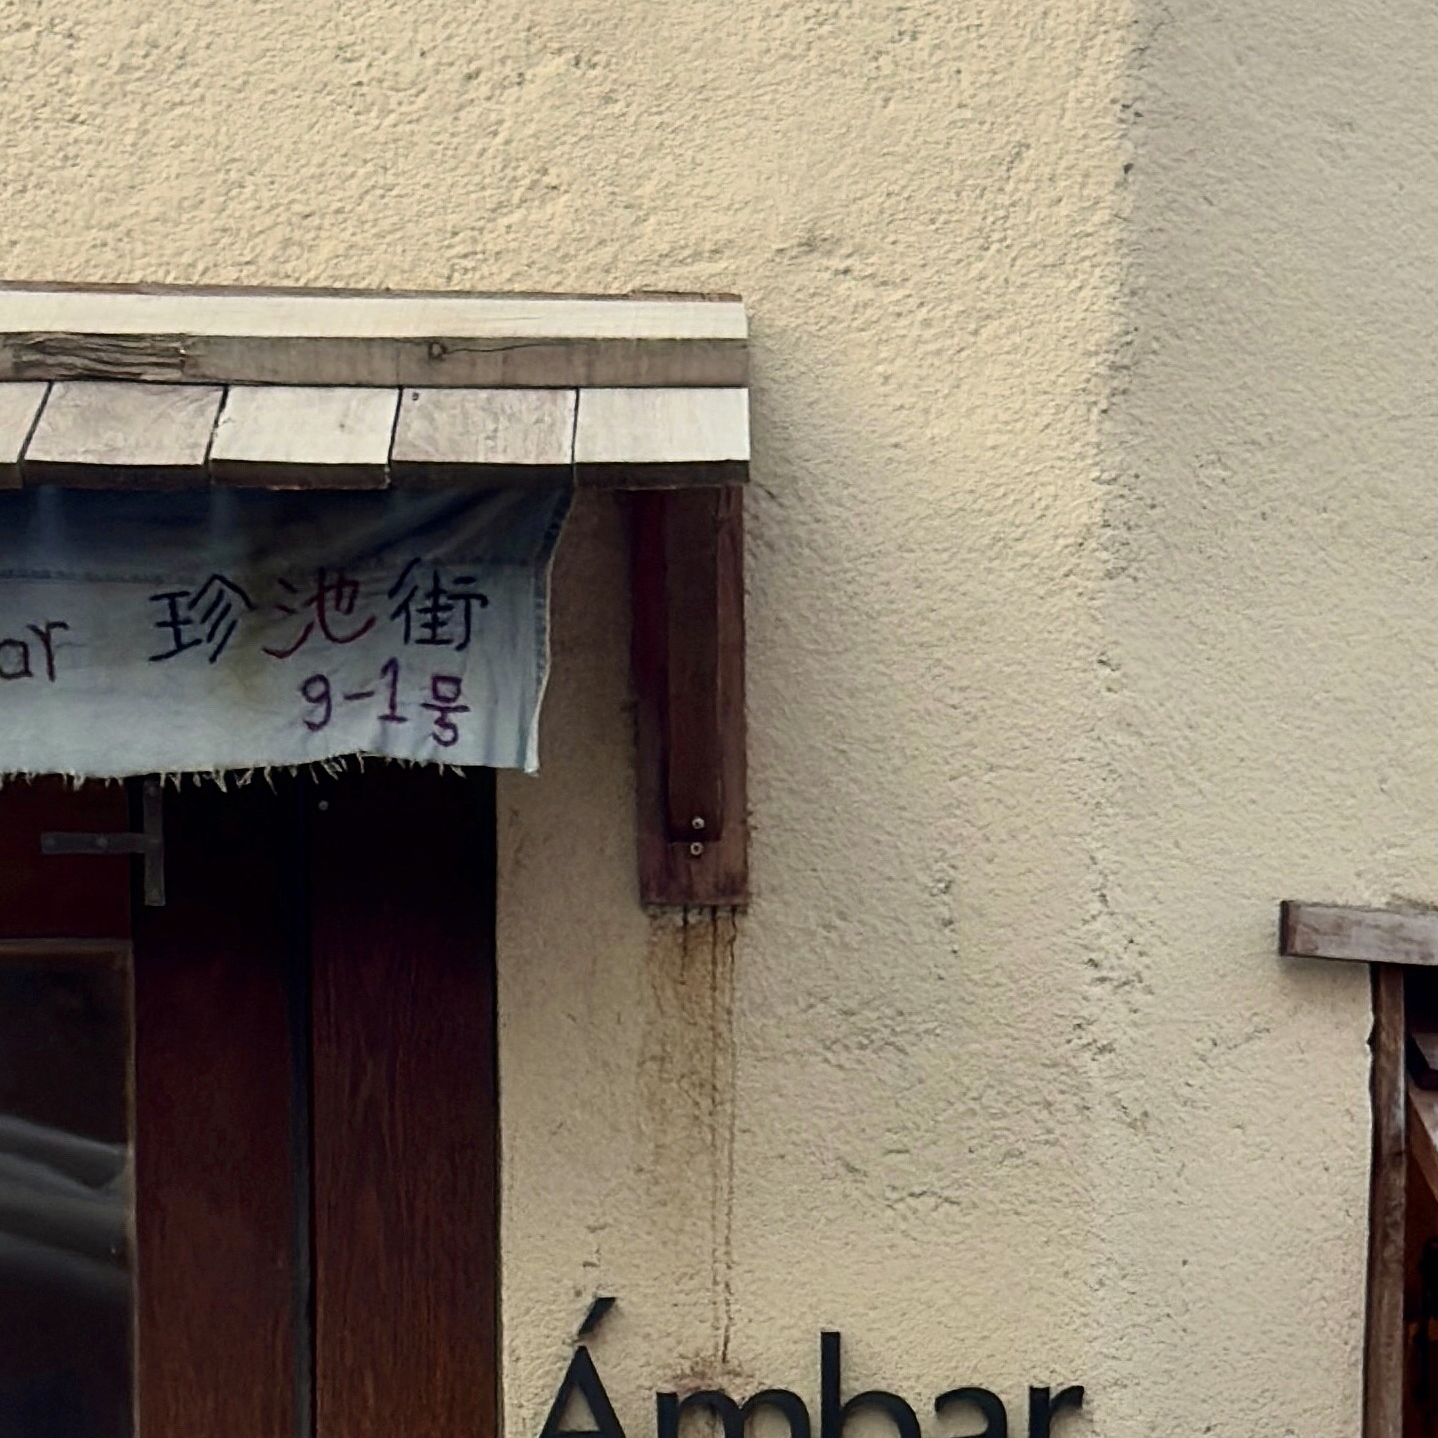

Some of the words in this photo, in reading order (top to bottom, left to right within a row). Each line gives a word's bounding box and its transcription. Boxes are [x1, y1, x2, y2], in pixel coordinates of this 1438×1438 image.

[146, 556, 490, 666] 珍池街
[299, 656, 471, 748] 9-1号
